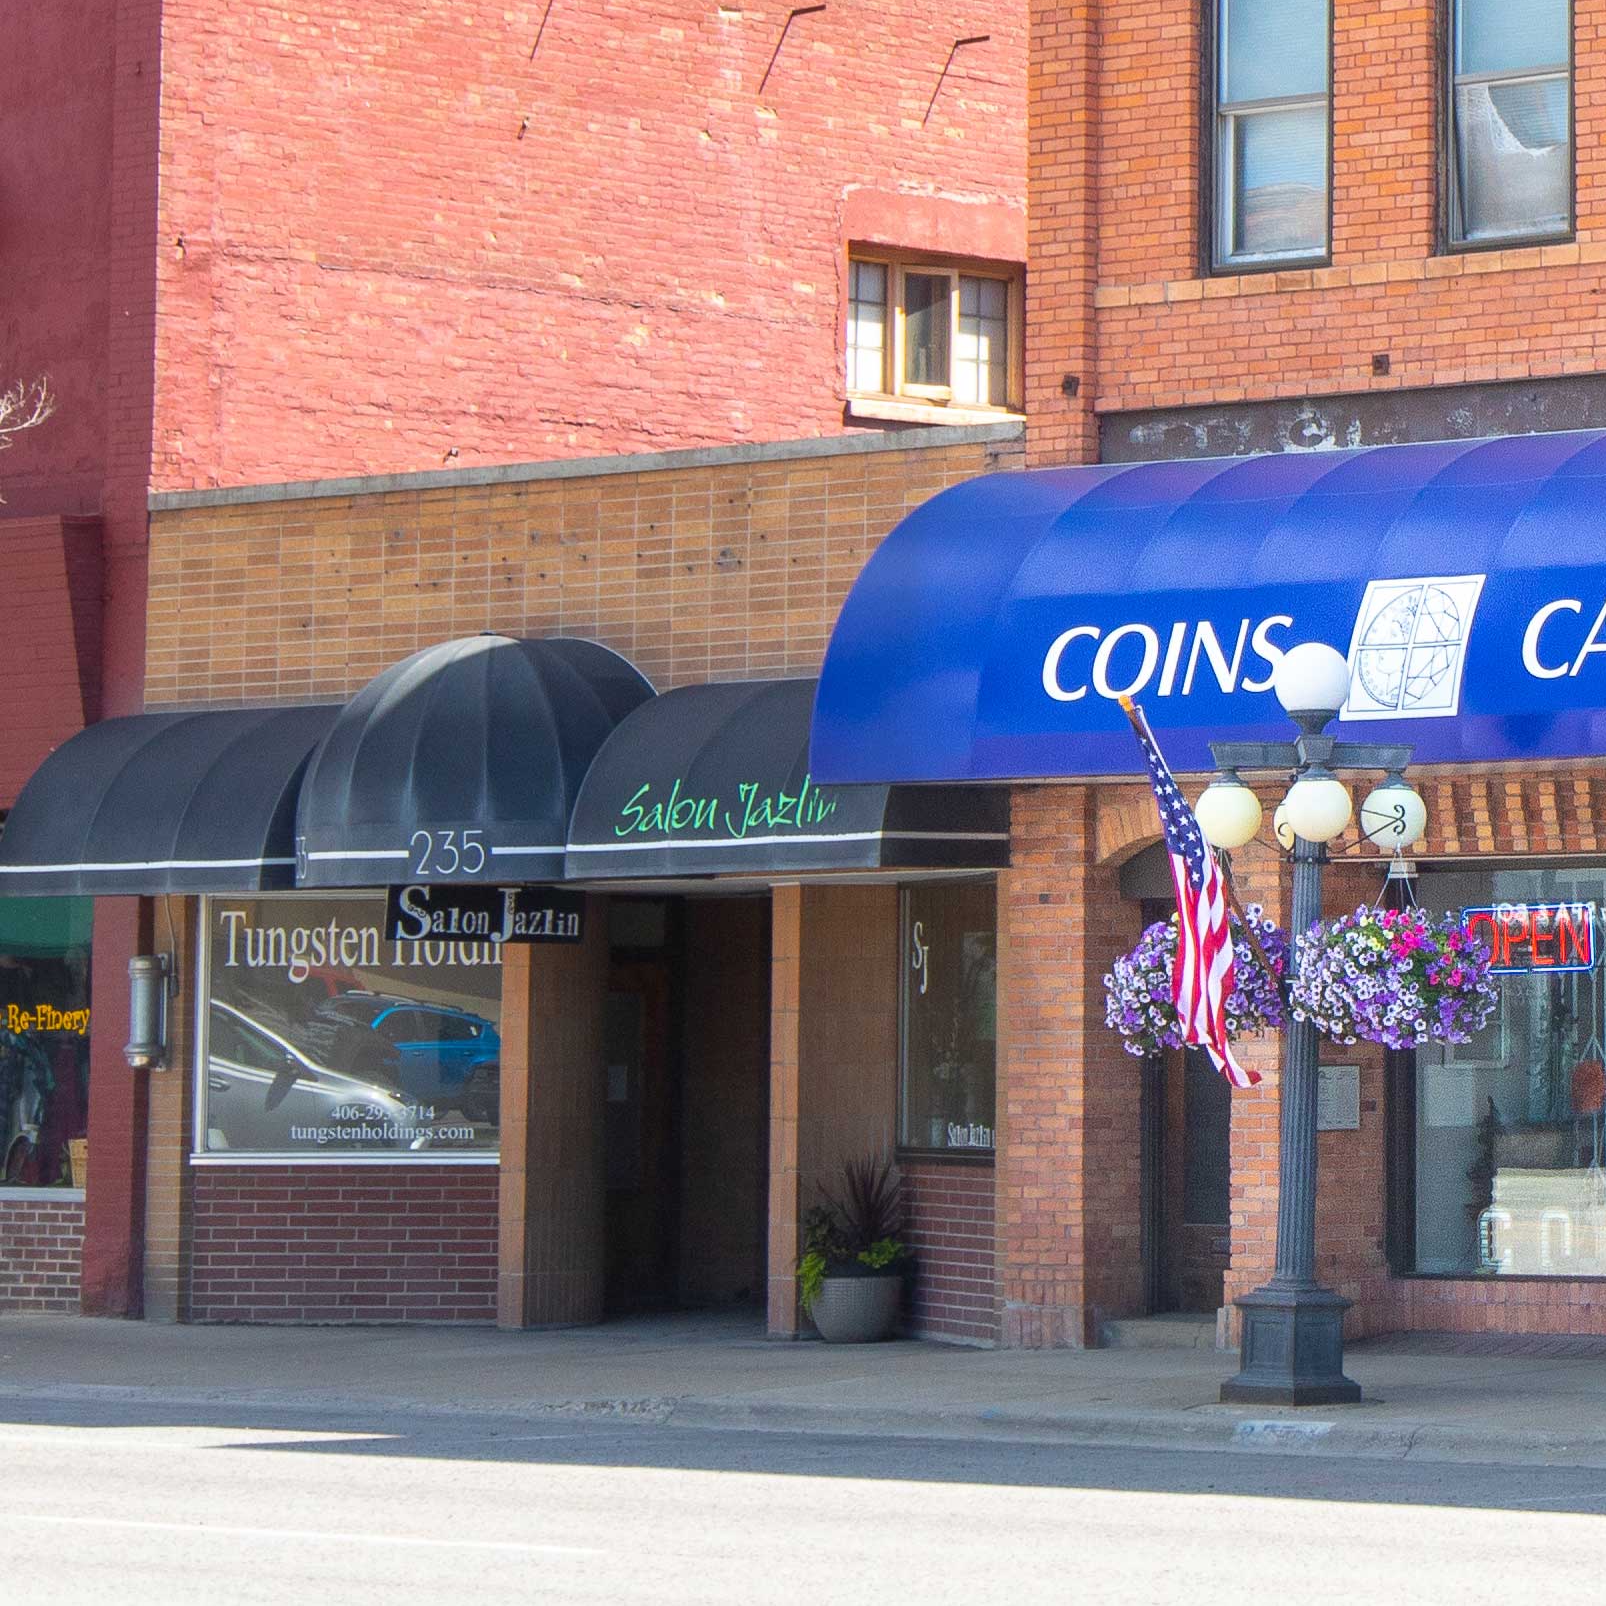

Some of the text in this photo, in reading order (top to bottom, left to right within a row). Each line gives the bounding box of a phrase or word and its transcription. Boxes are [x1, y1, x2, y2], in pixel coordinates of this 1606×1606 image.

[1042, 614, 1294, 702] COINS
[615, 783, 718, 836] Salon
[410, 830, 485, 875] 235
[397, 885, 579, 942] Salon Jazlin
[1468, 911, 1590, 966] OPEN
[220, 911, 381, 984] Tungsten
[290, 1122, 474, 1144] tungstenholdings.com
